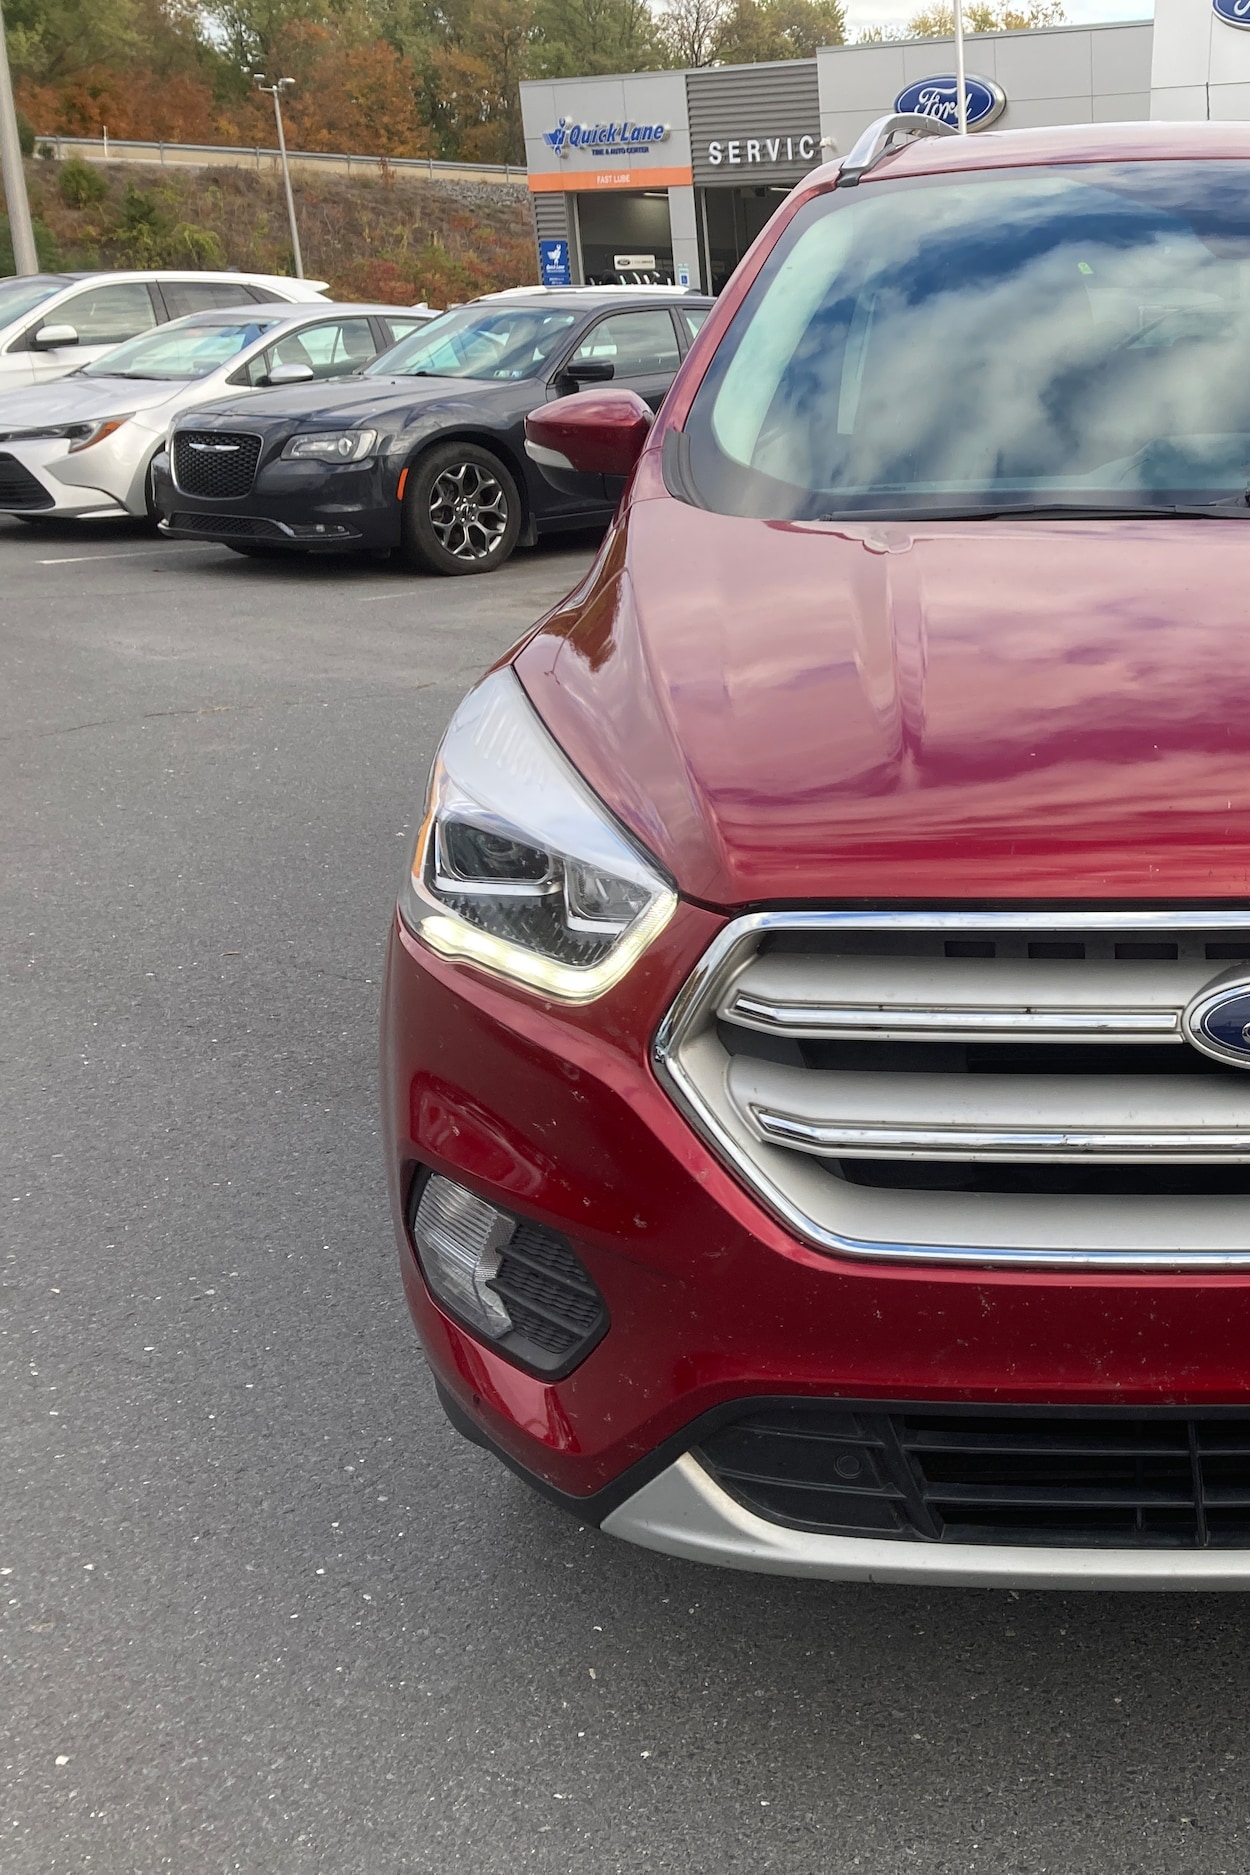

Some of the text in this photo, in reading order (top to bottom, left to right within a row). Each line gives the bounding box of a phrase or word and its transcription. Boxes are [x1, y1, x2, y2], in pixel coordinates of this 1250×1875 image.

[569, 122, 665, 147] Quick Lane
[596, 174, 631, 184] FAST LUBE
